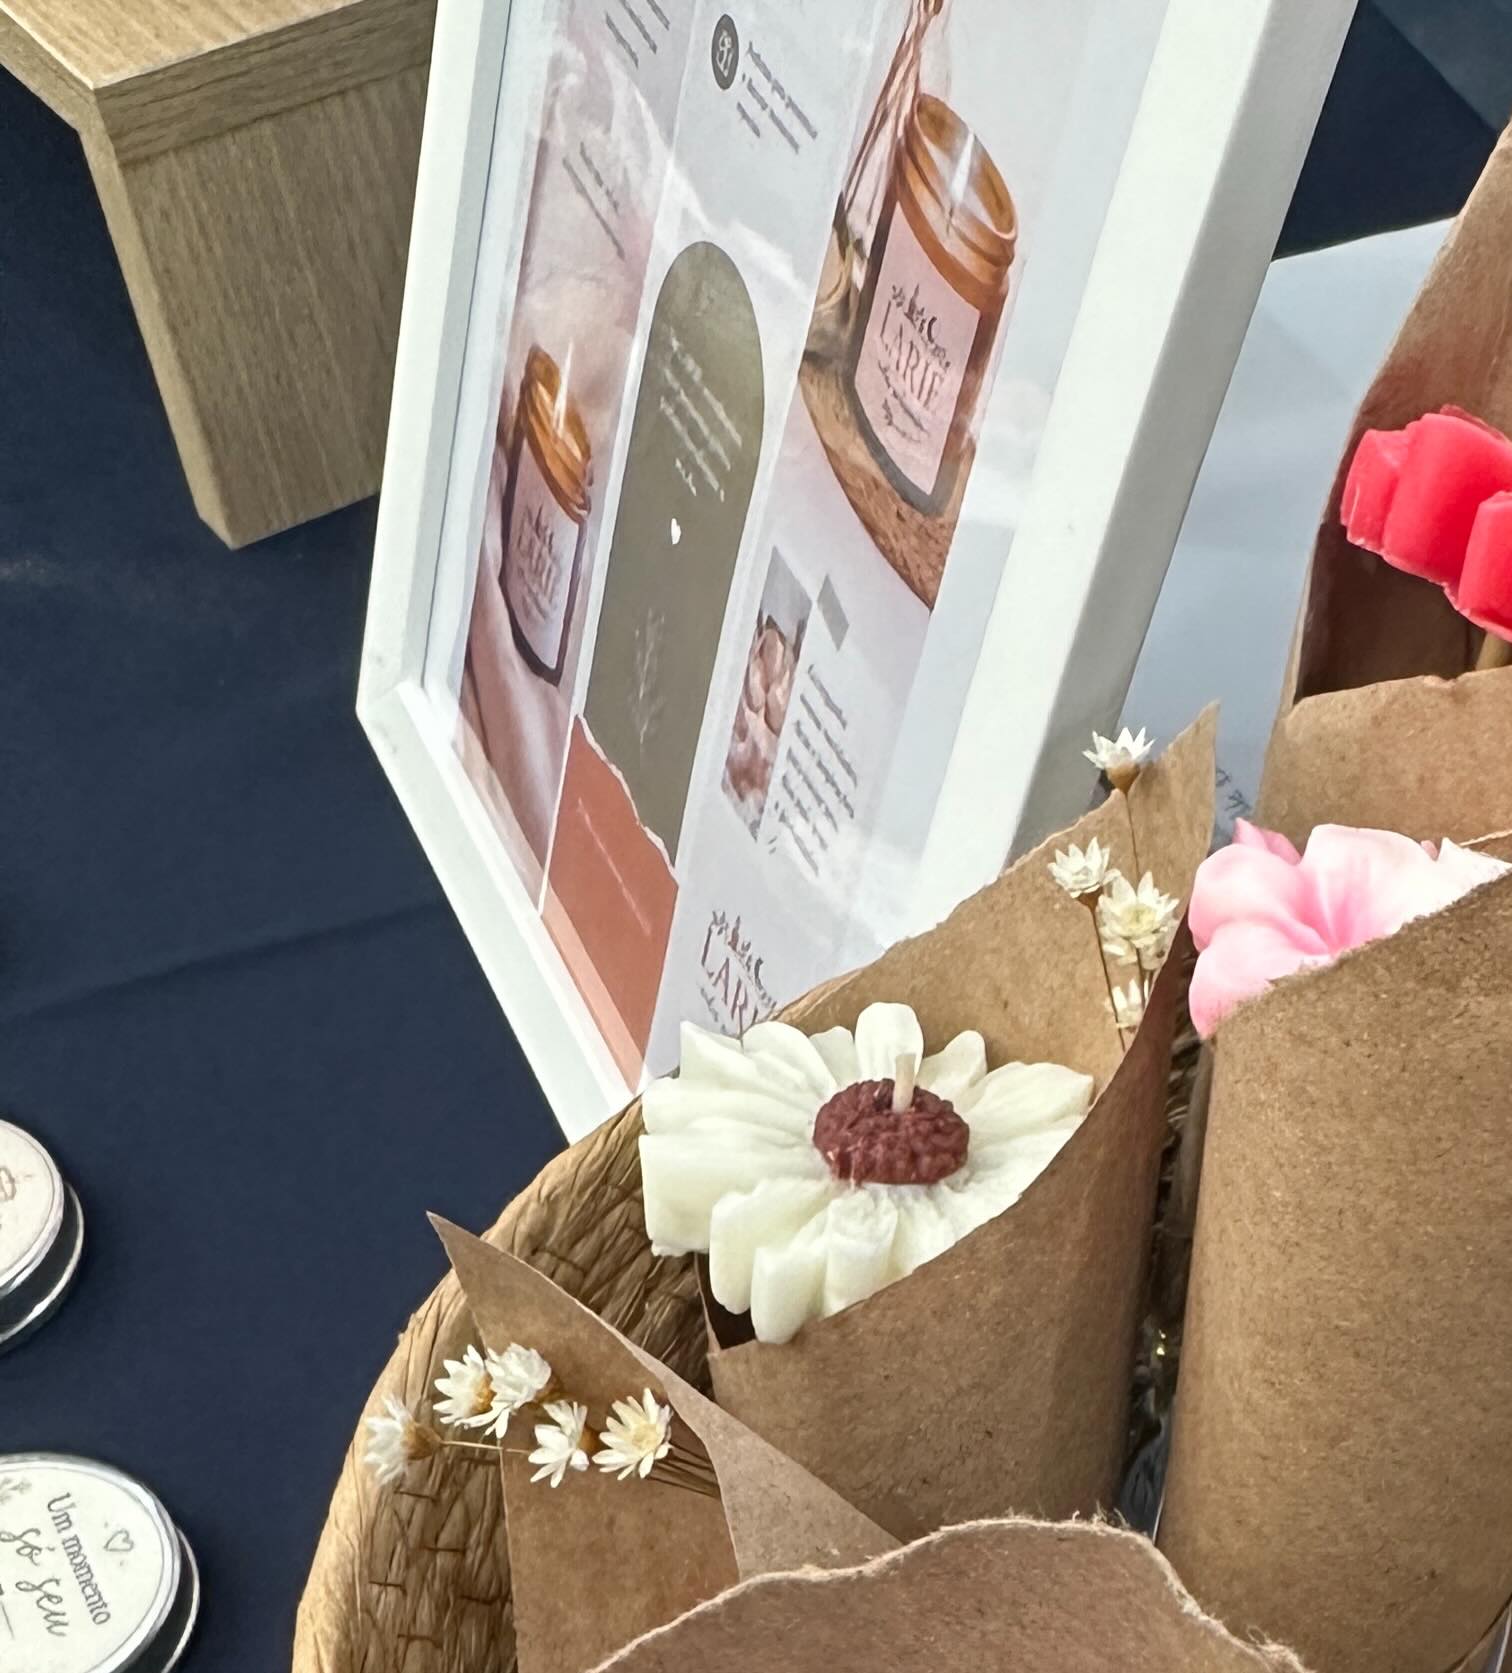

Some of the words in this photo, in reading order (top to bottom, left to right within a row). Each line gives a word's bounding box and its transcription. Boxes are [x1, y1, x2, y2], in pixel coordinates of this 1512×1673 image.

[701, 920, 758, 1035] LAR
[48, 1492, 76, 1534] Um
[15, 1577, 69, 1637] seu
[61, 1534, 111, 1626] momento
